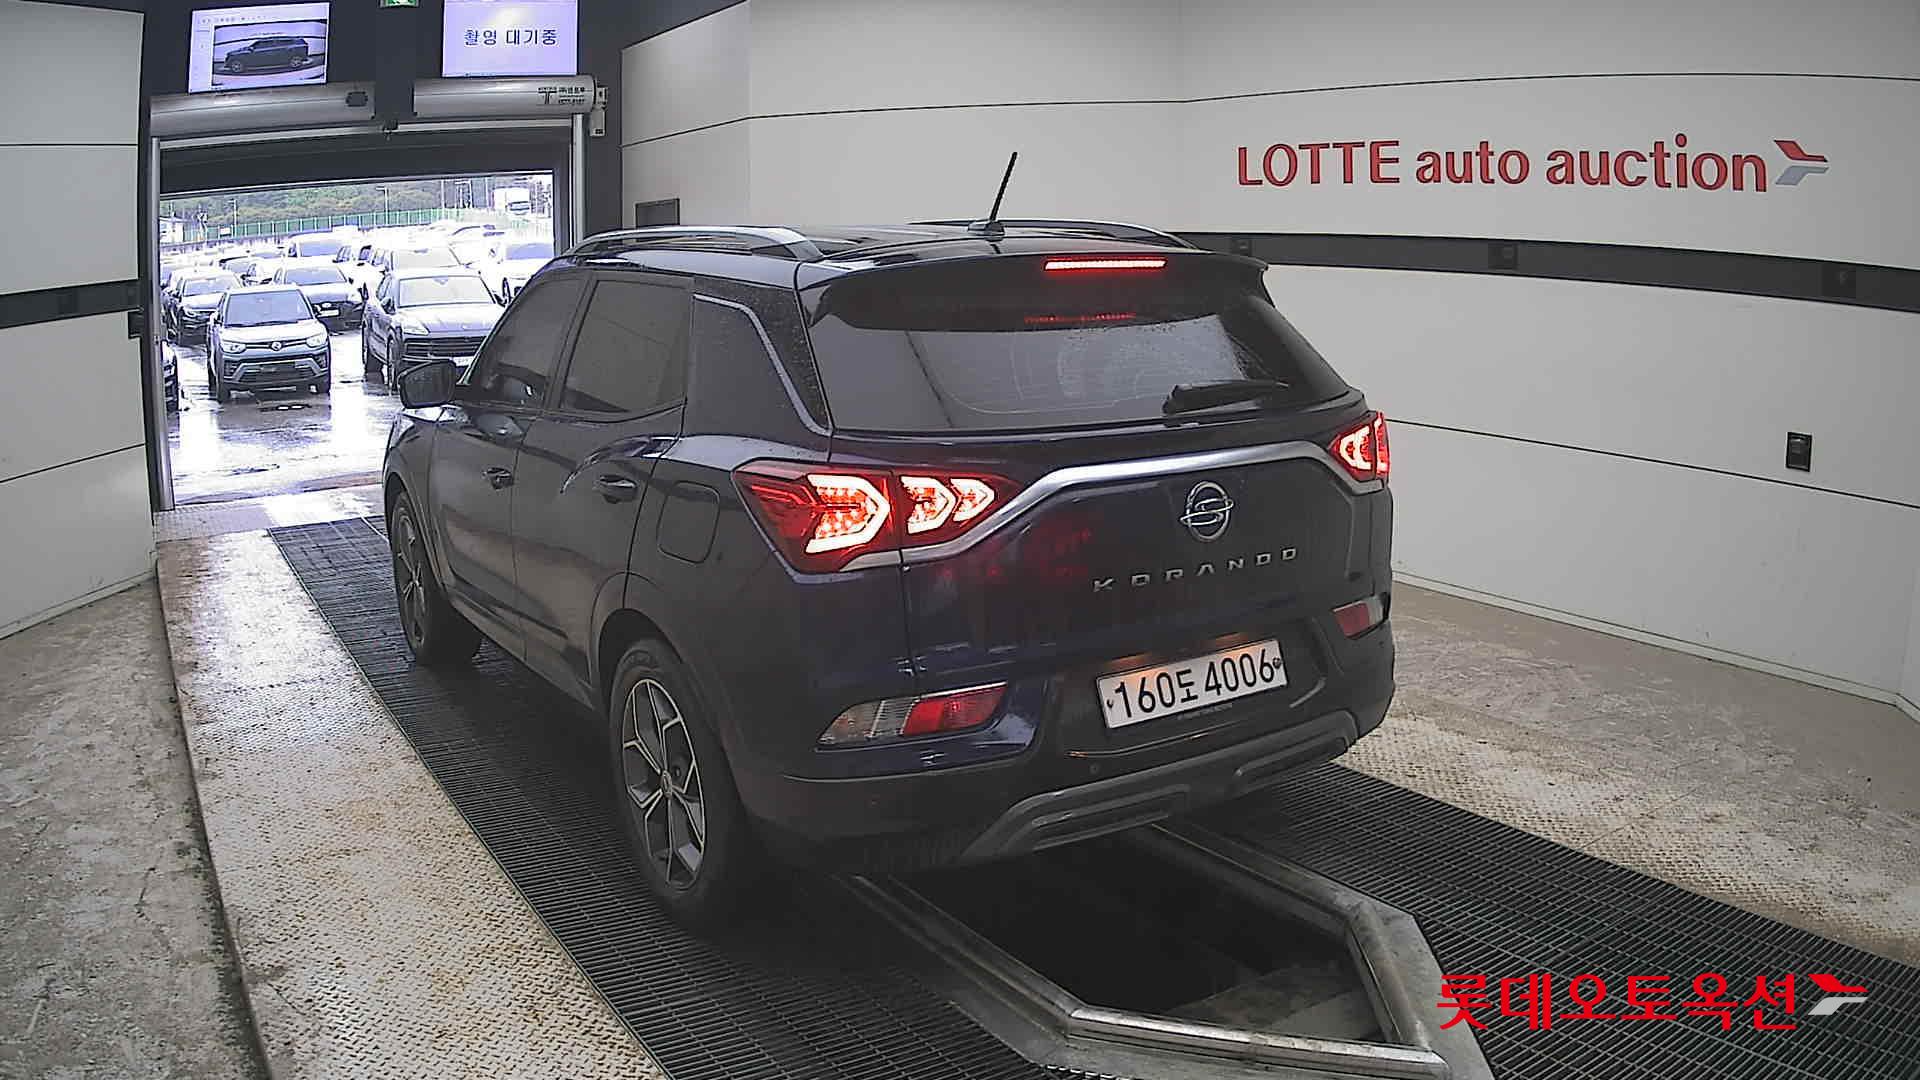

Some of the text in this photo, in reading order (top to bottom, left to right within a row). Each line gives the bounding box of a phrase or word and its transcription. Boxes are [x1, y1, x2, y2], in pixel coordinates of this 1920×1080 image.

[464, 29, 558, 46] 촬영 대기중
[1237, 133, 1767, 191] LOTTE auto auction
[1092, 548, 1298, 593] KORANDO
[1204, 648, 1275, 696] 4006
